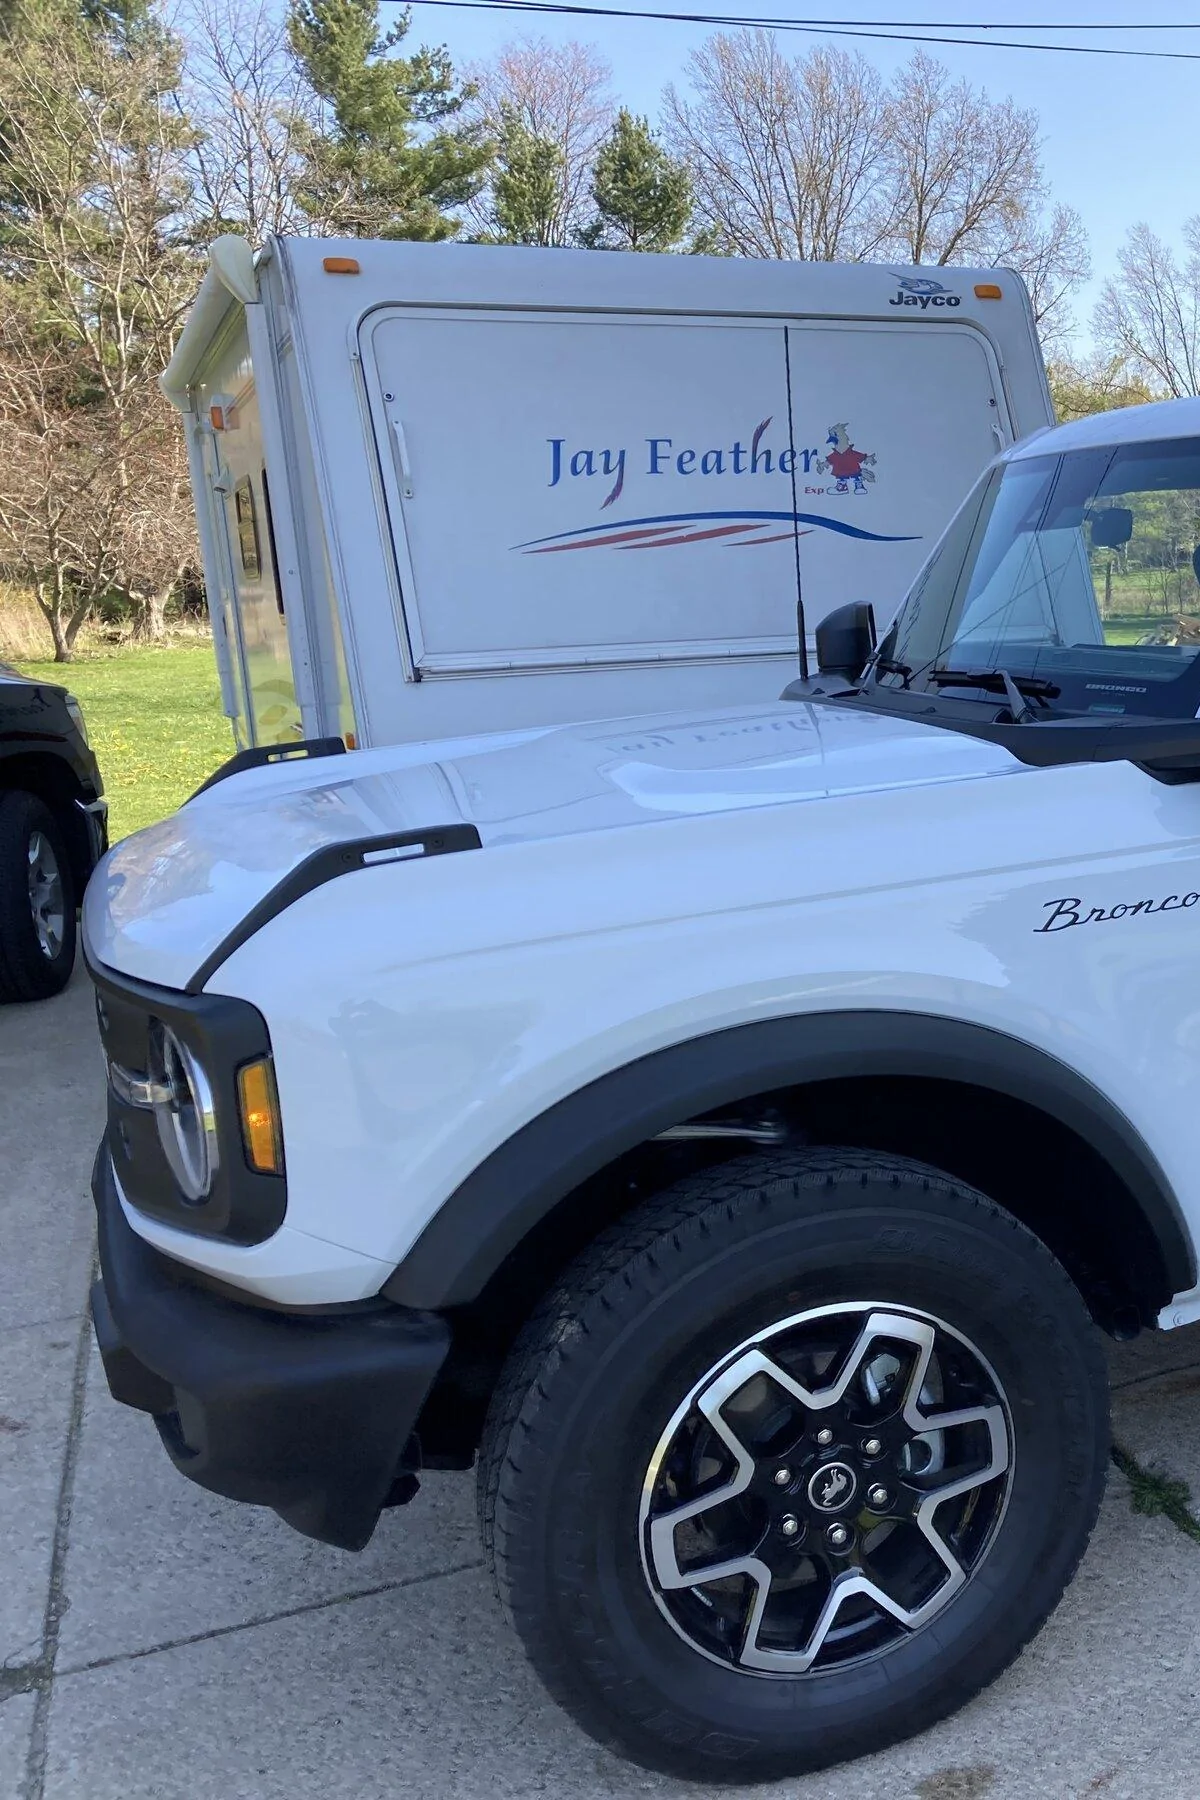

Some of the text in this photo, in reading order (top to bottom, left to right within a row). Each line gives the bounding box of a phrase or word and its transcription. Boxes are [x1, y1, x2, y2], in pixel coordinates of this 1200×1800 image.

[889, 291, 961, 309] Jayco
[546, 416, 818, 511] Jay Feather
[804, 486, 825, 496] Exp
[1084, 683, 1147, 693] BRONCO
